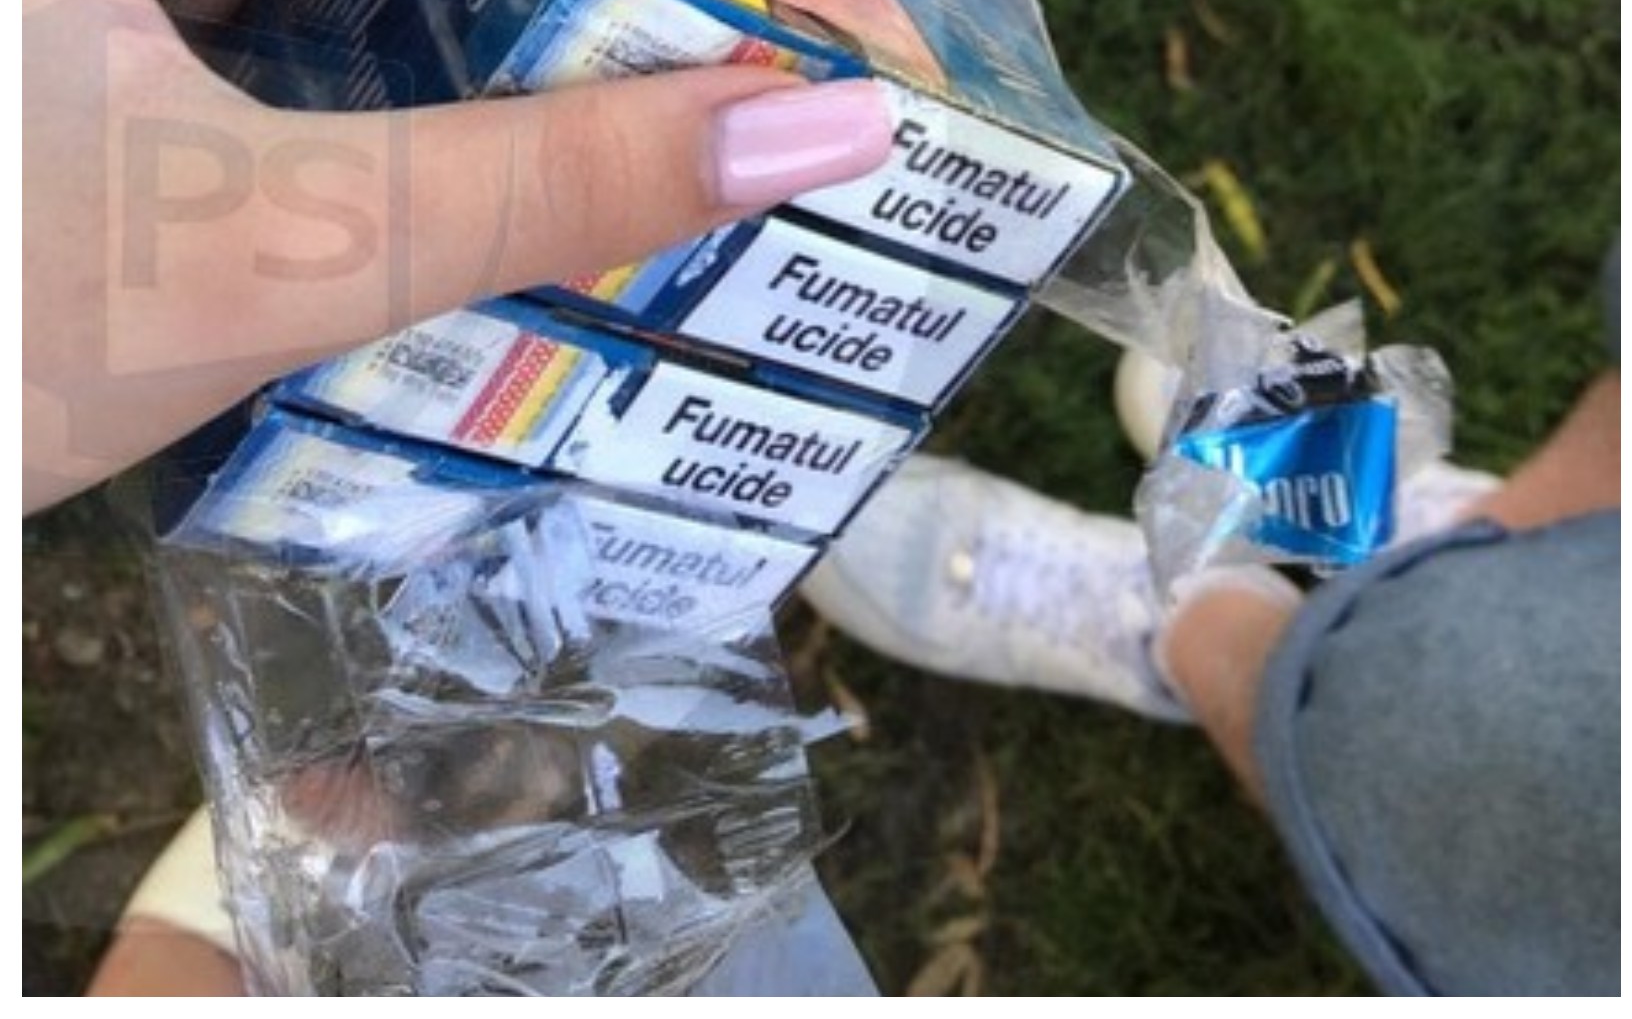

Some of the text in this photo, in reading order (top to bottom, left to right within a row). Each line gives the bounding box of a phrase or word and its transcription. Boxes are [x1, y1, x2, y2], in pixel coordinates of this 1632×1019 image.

[895, 118, 1071, 220] Fumatul
[872, 188, 996, 253] ucide
[770, 253, 967, 343] Fumatul
[763, 315, 892, 372] ucide
[663, 395, 862, 475] Fumatul
[662, 458, 792, 508] ucide
